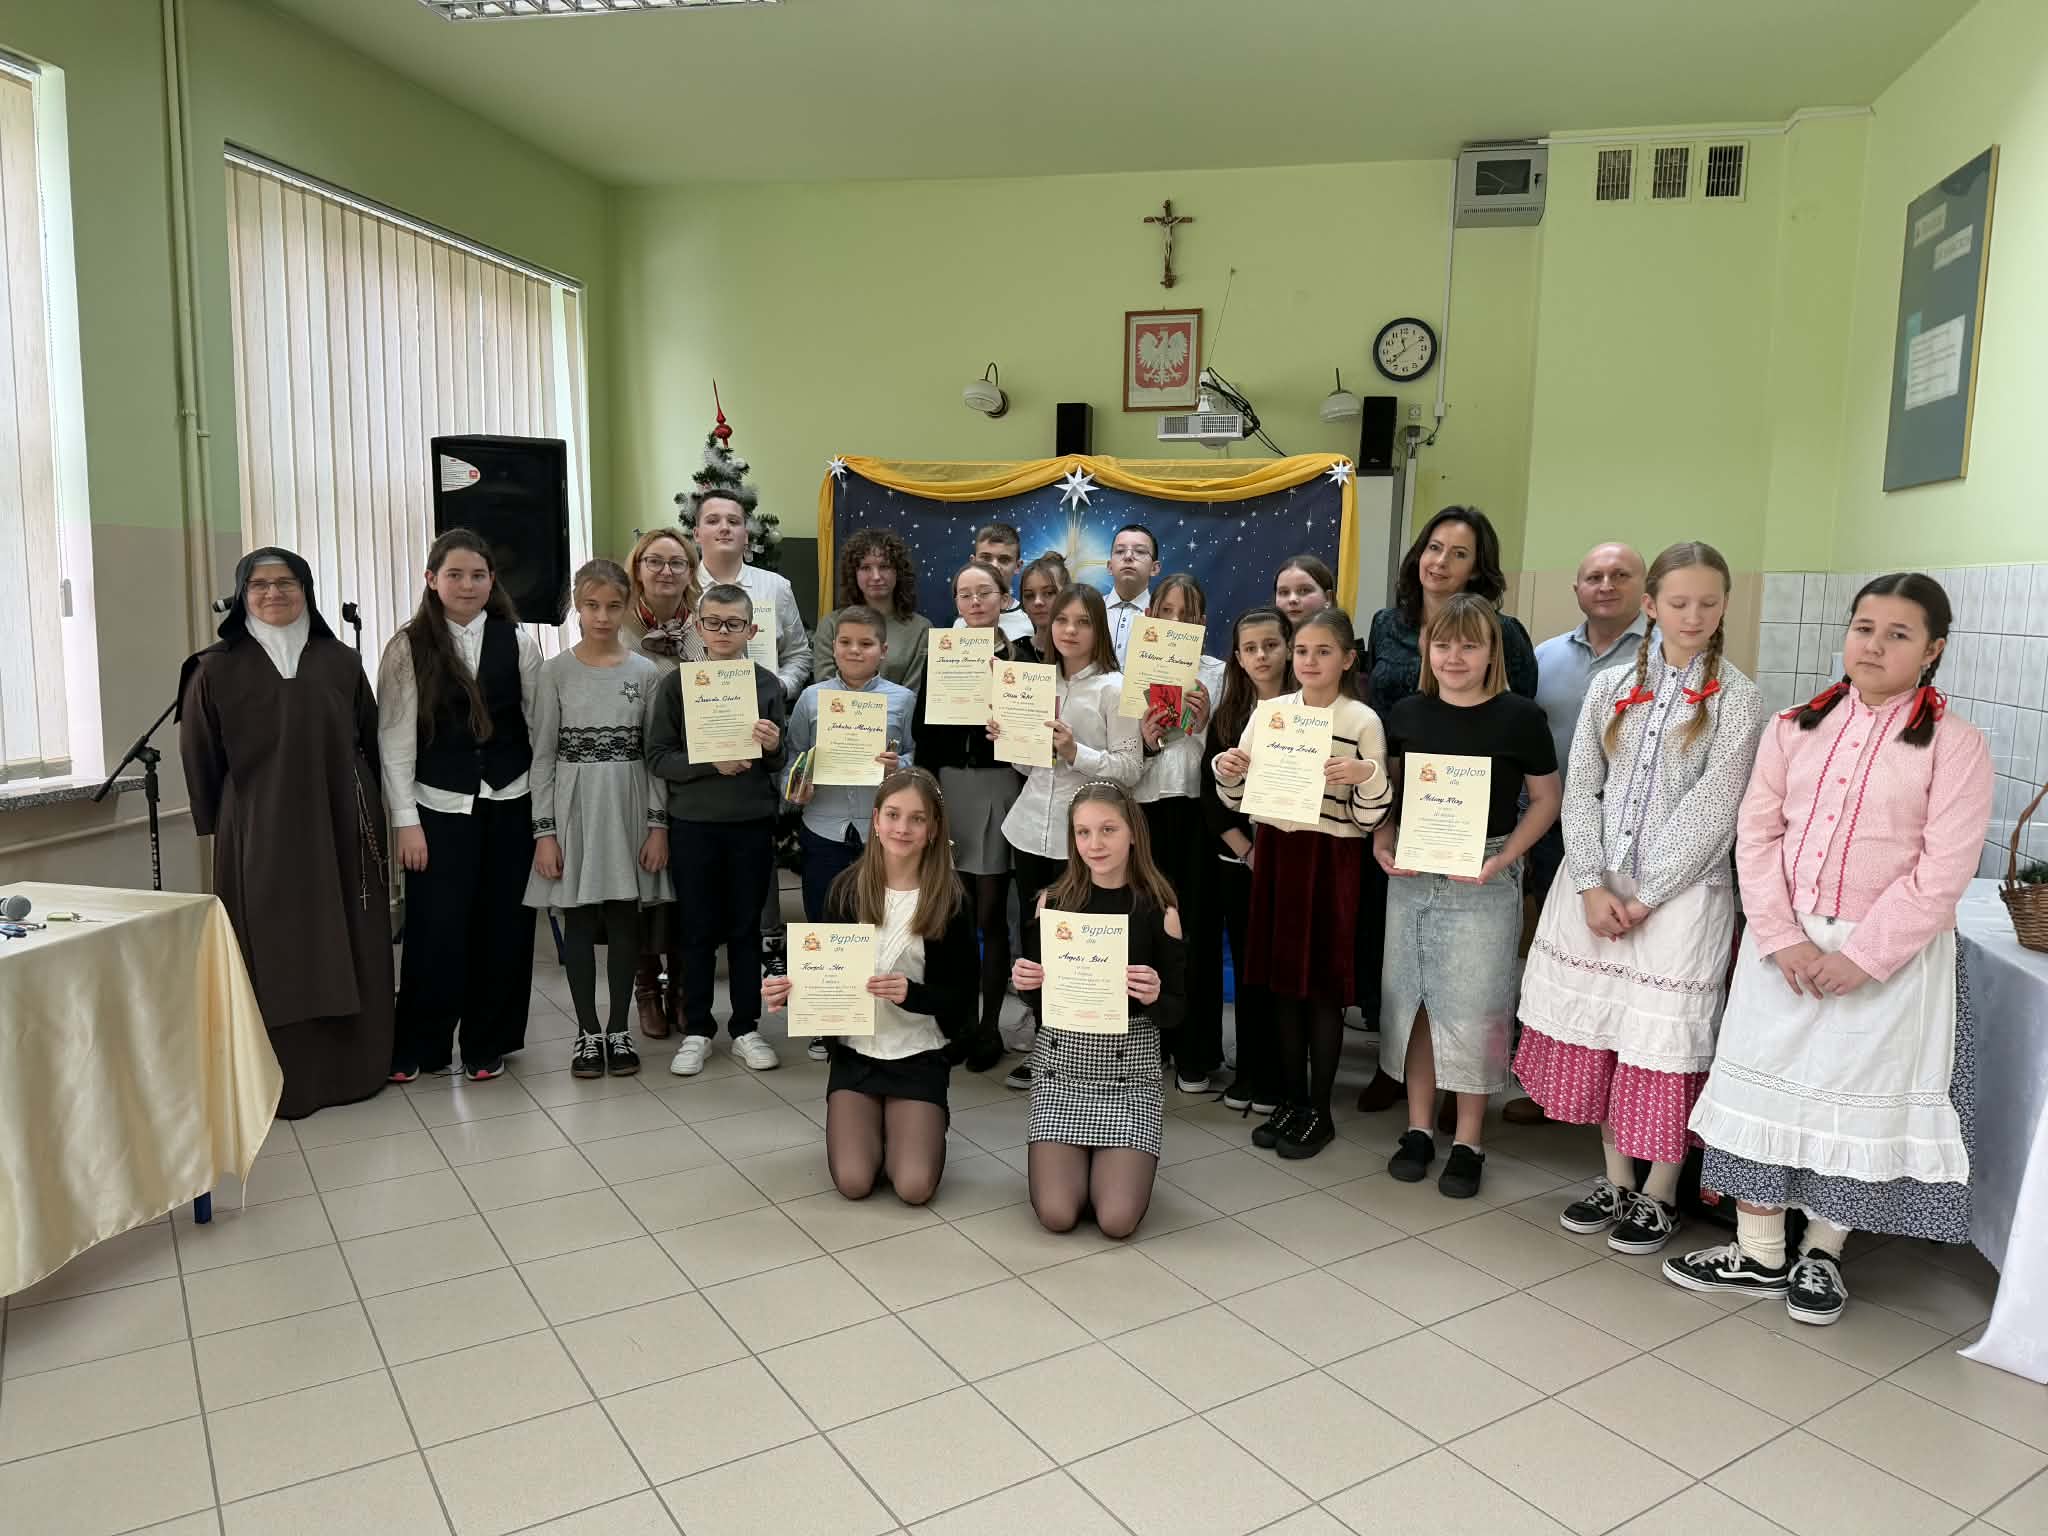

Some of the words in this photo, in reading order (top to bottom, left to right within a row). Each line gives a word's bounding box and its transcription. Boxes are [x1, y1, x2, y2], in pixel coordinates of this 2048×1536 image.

[960, 636, 990, 647] Dyplom
[1166, 629, 1199, 642] Dyplom
[718, 669, 751, 679] Dyplom
[1022, 671, 1051, 682] Dyplom
[851, 699, 883, 710] Dyplom
[1293, 714, 1328, 728] Dyplom
[1446, 765, 1486, 777] Dyplom
[1081, 924, 1123, 936] Dyplom
[830, 933, 870, 945] Dyplom
